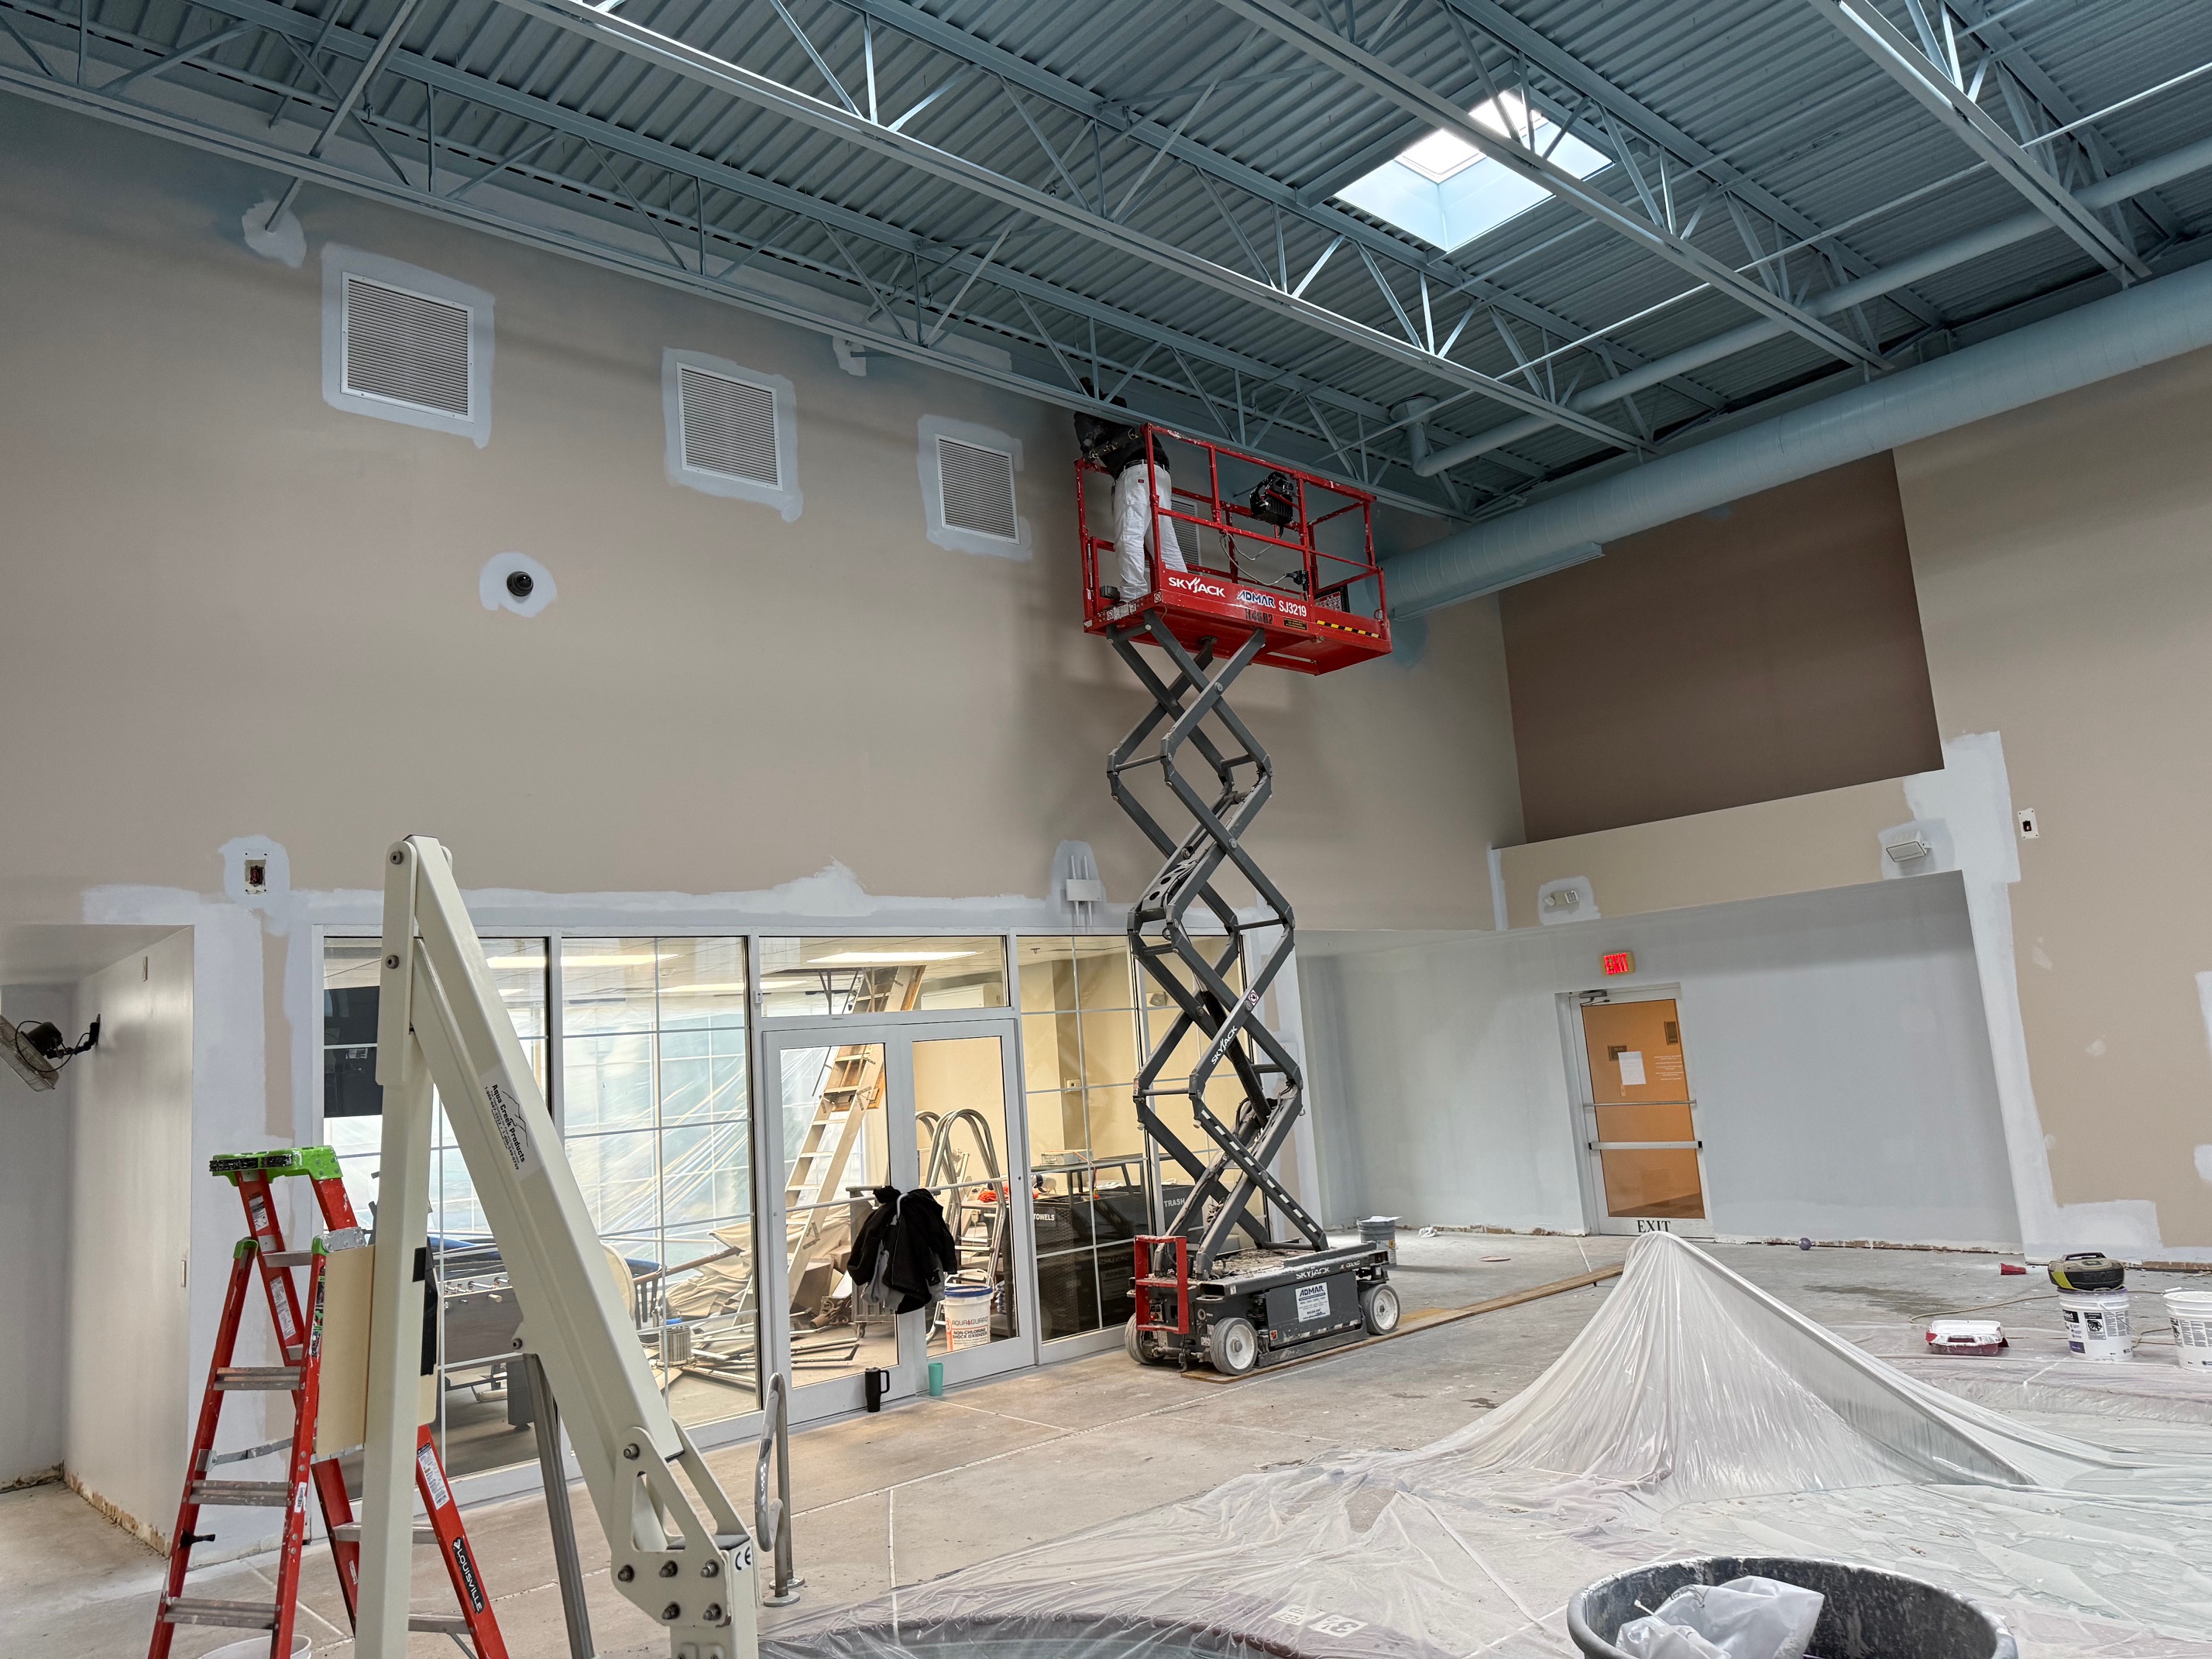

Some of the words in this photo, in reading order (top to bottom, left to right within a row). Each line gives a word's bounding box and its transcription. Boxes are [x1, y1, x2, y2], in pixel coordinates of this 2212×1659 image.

[1168, 576, 1225, 598] SKYJACK
[1238, 590, 1276, 608] ADMAR
[1279, 599, 1307, 617] SJ3219
[1604, 953, 1628, 974] EXIT
[1211, 1025, 1238, 1065] SKYJACK
[492, 1084, 502, 1104] Aqua
[500, 1104, 512, 1127] Creek
[509, 1127, 525, 1163] Products
[1163, 1197, 1186, 1207] TRASH
[1034, 1213, 1055, 1221] TOWELS
[1637, 1219, 1671, 1233] EXIT
[1299, 1285, 1324, 1297] ADMAR
[457, 1548, 483, 1612] LOUISVILLE
